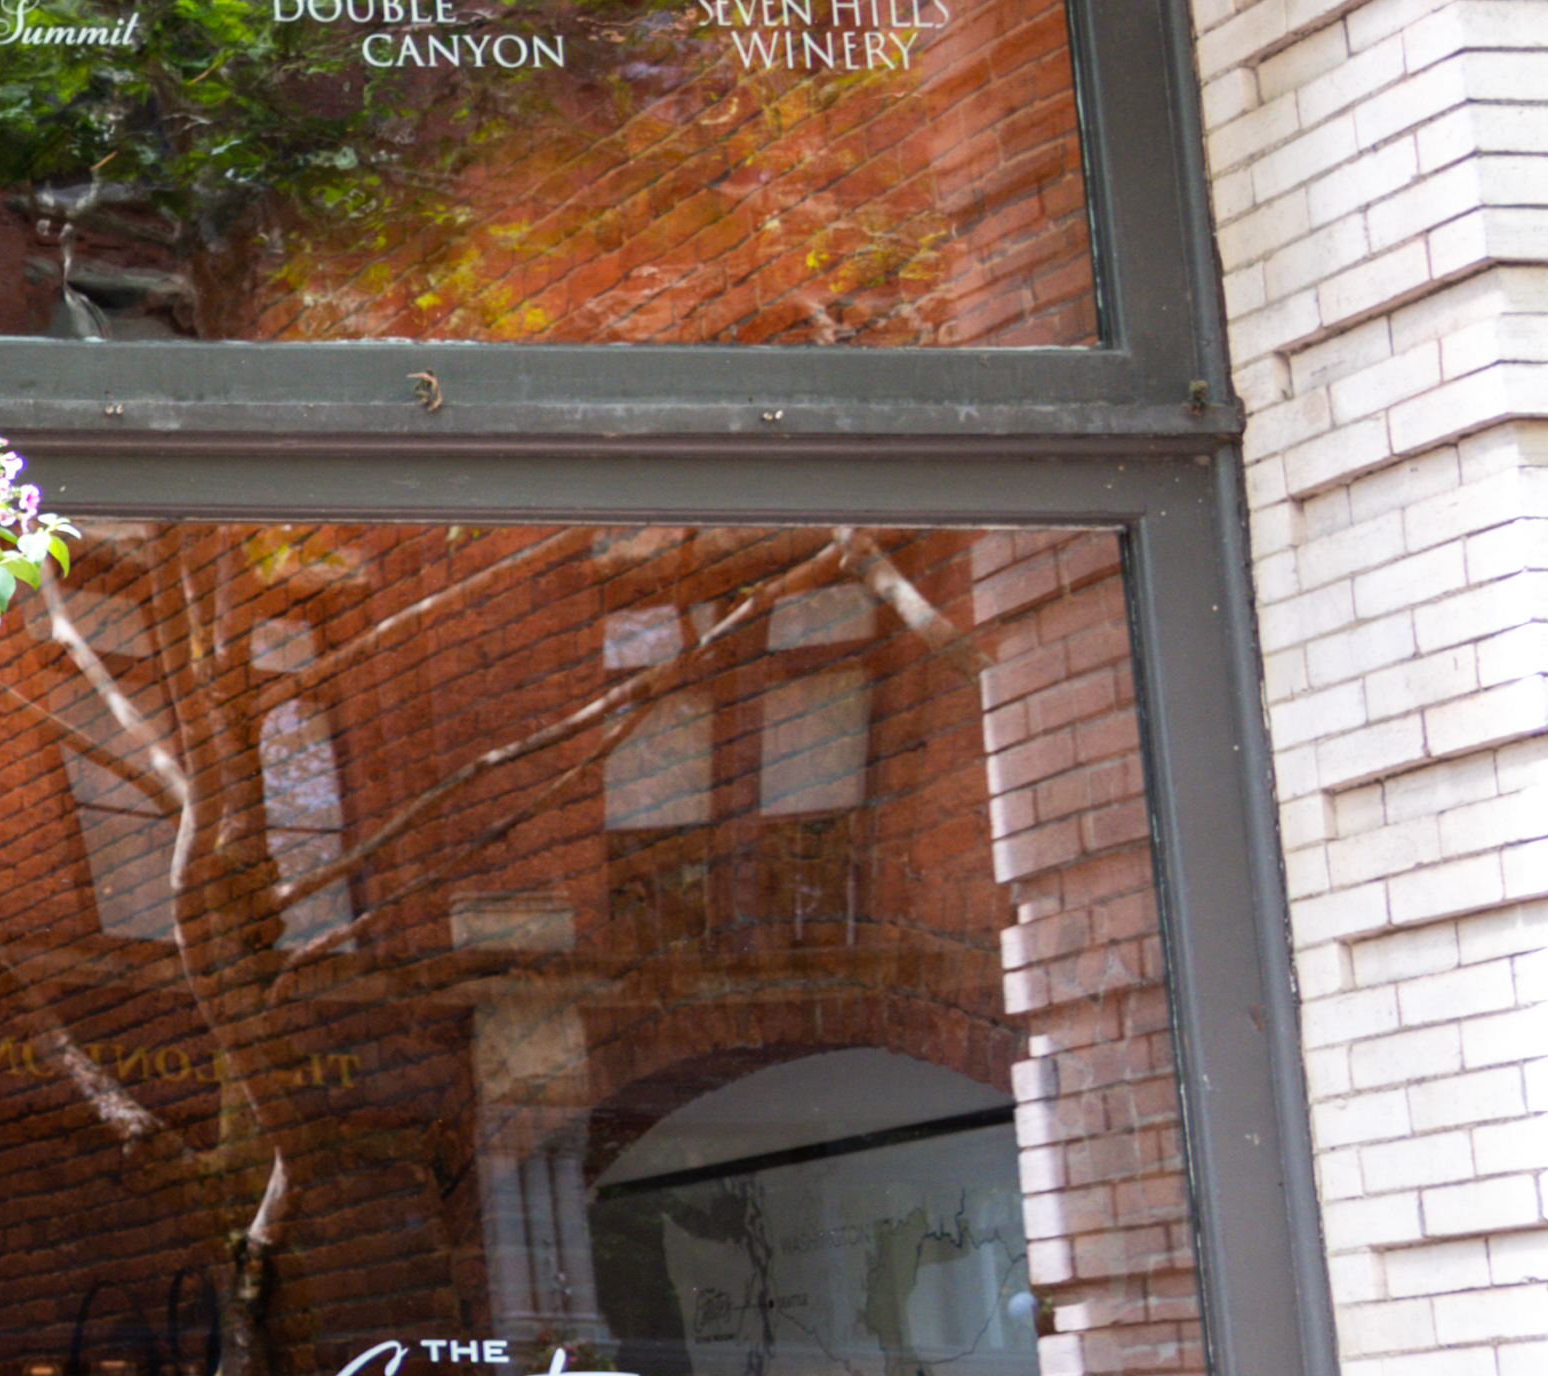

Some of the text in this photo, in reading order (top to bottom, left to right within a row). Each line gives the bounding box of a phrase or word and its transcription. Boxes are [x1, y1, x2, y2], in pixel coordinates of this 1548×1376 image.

[361, 33, 565, 68] CANYON
[730, 30, 919, 71] WINERY
[420, 1339, 510, 1363] THE
